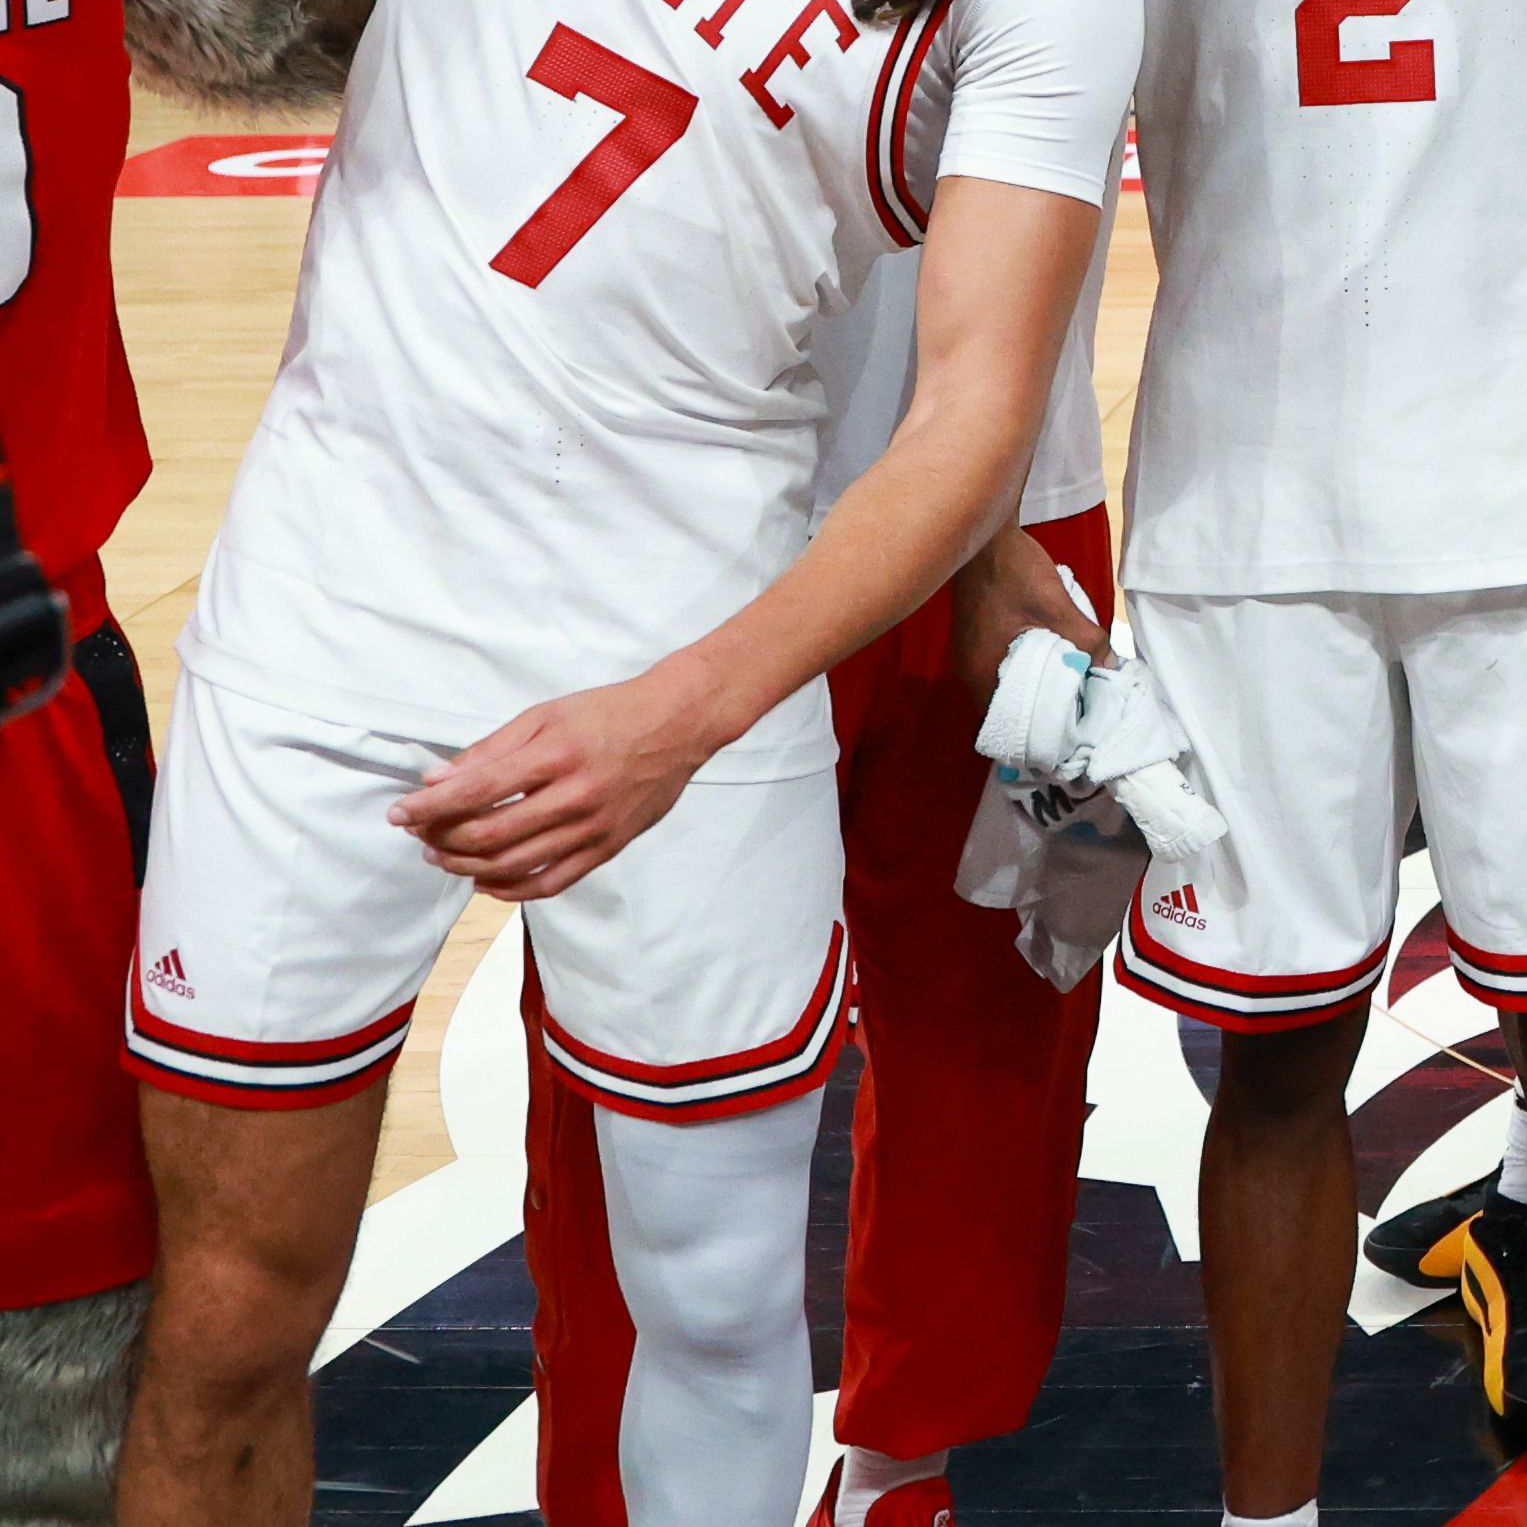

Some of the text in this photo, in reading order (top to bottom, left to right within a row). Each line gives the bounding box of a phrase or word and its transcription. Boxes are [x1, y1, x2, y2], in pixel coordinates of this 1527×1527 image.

[490, 22, 699, 289] 7
[1152, 901, 1207, 931] adidas
[146, 968, 196, 1000] adidas
